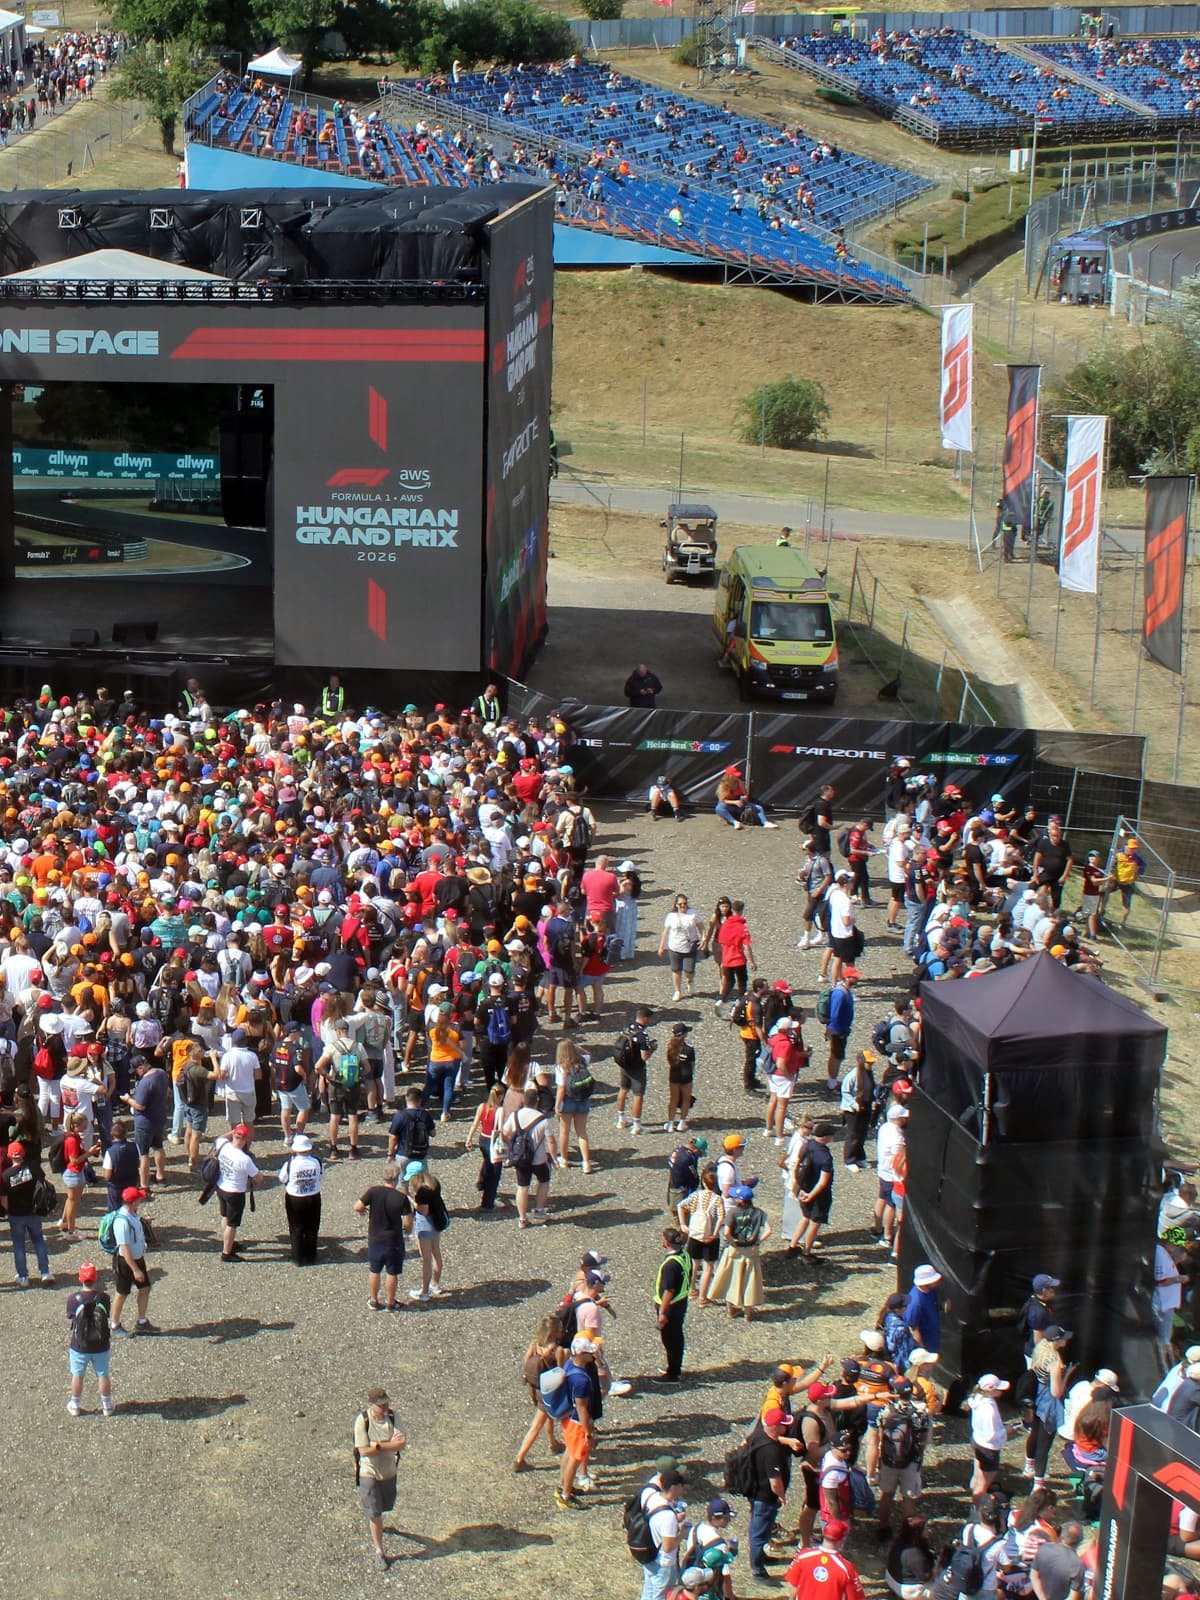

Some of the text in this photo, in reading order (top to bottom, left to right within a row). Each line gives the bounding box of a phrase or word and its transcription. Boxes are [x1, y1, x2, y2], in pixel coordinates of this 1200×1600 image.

[56, 330, 158, 355] STAGE
[49, 451, 214, 472] allwyn allwyn allwyn
[400, 469, 430, 482] aws
[332, 493, 382, 501] FORMULA
[296, 506, 458, 527] HUNGARIAN
[296, 526, 458, 547] GRAND PRIX
[357, 552, 396, 562] 2026
[647, 741, 686, 749] Heineken
[796, 746, 886, 759] FANZONE
[931, 754, 972, 763] Heineken
